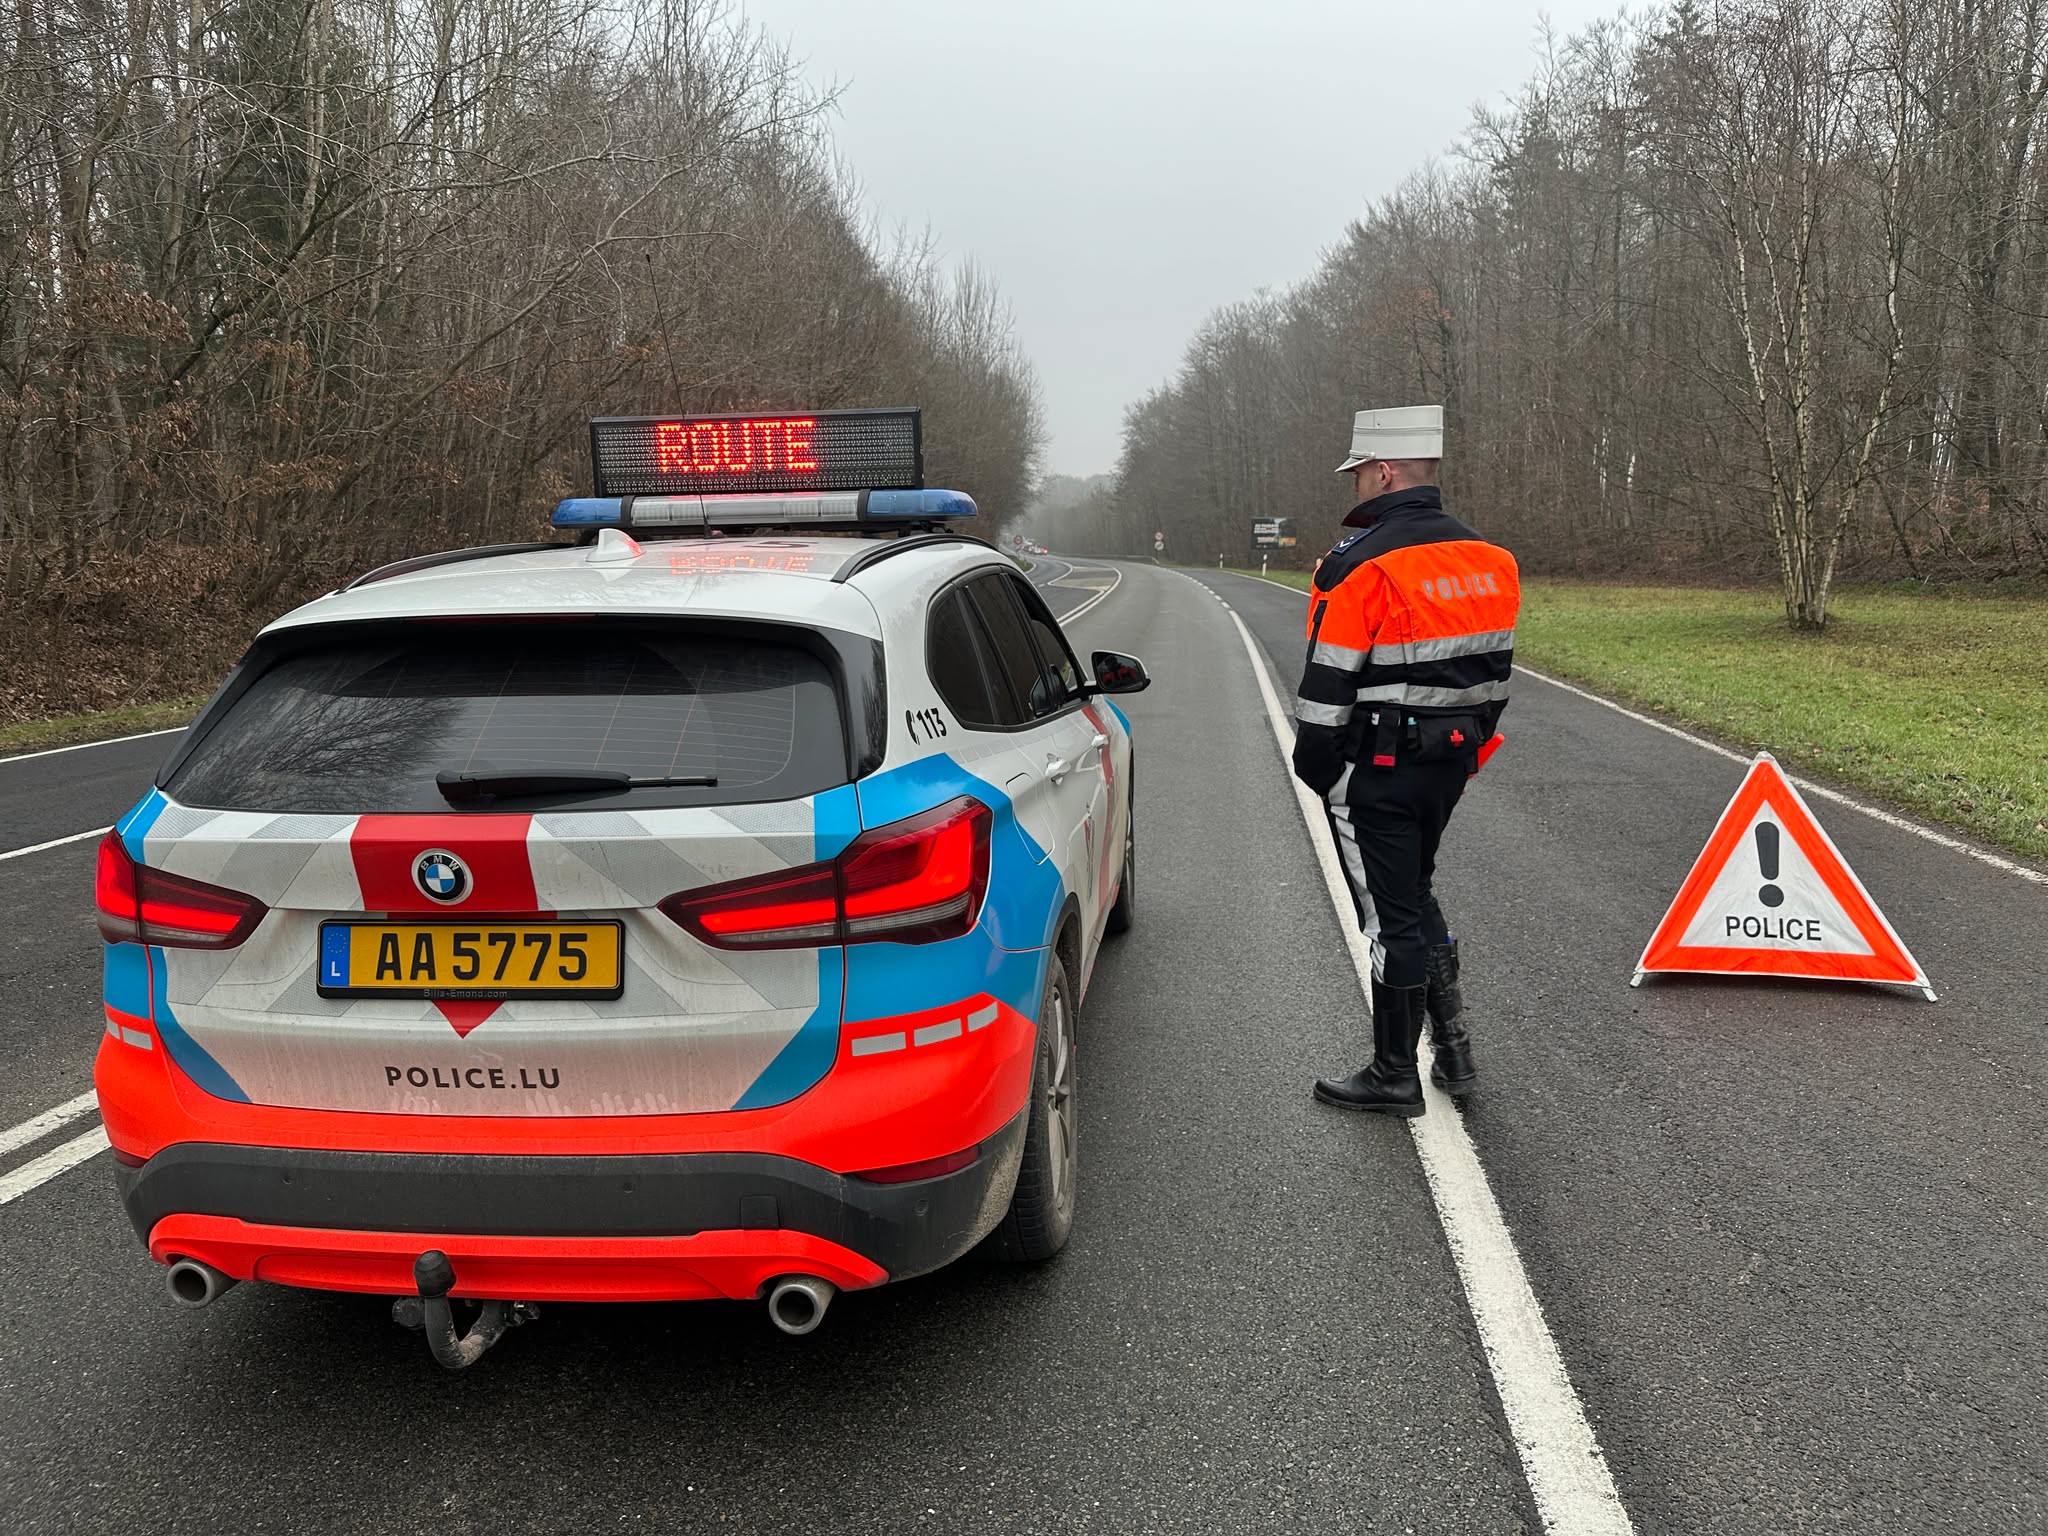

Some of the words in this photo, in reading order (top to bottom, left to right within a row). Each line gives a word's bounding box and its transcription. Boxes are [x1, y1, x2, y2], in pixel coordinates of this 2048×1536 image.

[657, 420, 816, 474] ROUTE
[1422, 573, 1498, 600] POLICE
[916, 708, 947, 739] 113
[420, 855, 460, 870] BMW
[1725, 916, 1822, 940] POLICE
[331, 961, 341, 977] L
[375, 933, 436, 980] AA
[452, 933, 587, 981] 5775
[385, 1066, 560, 1089] POLICE.LU
